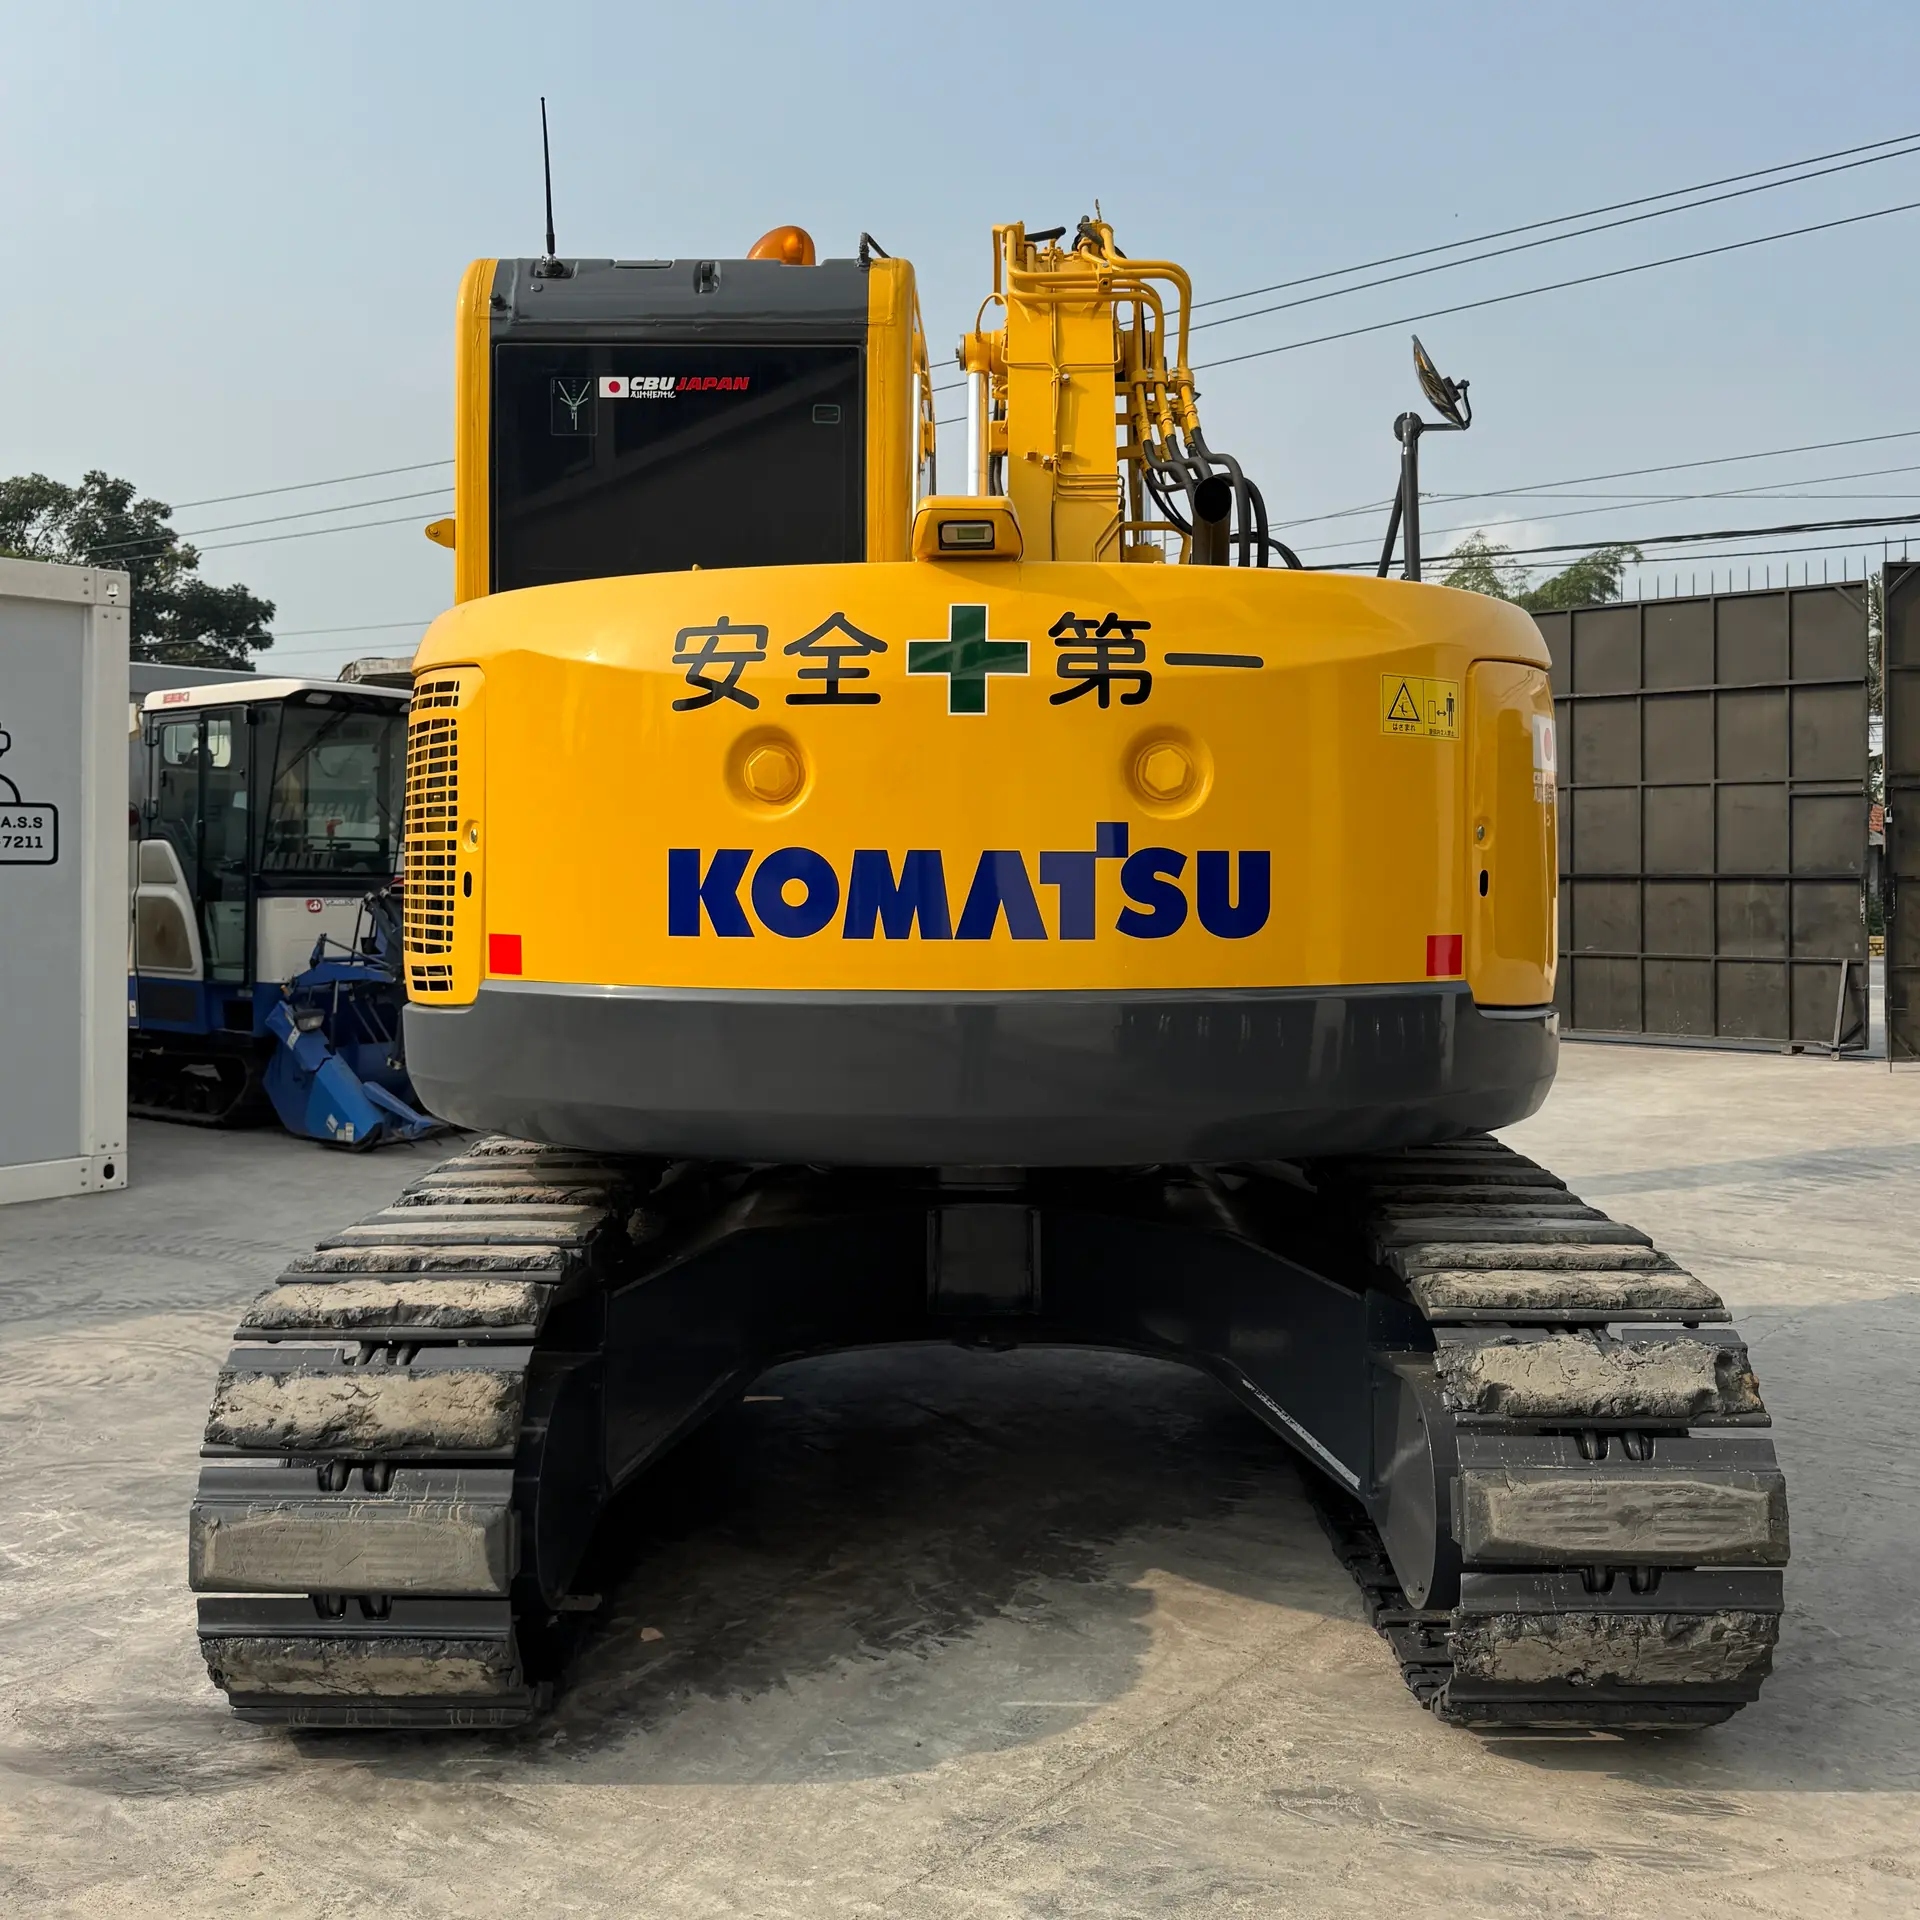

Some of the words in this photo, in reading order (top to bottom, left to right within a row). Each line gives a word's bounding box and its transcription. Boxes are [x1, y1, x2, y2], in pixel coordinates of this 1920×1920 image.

[630, 376, 675, 390] CBU
[676, 376, 750, 391] JAPAN
[672, 612, 888, 711] 安全
[1048, 612, 1264, 709] 第一
[0, 836, 43, 849] 7211
[668, 822, 1271, 940] KOMATSU
